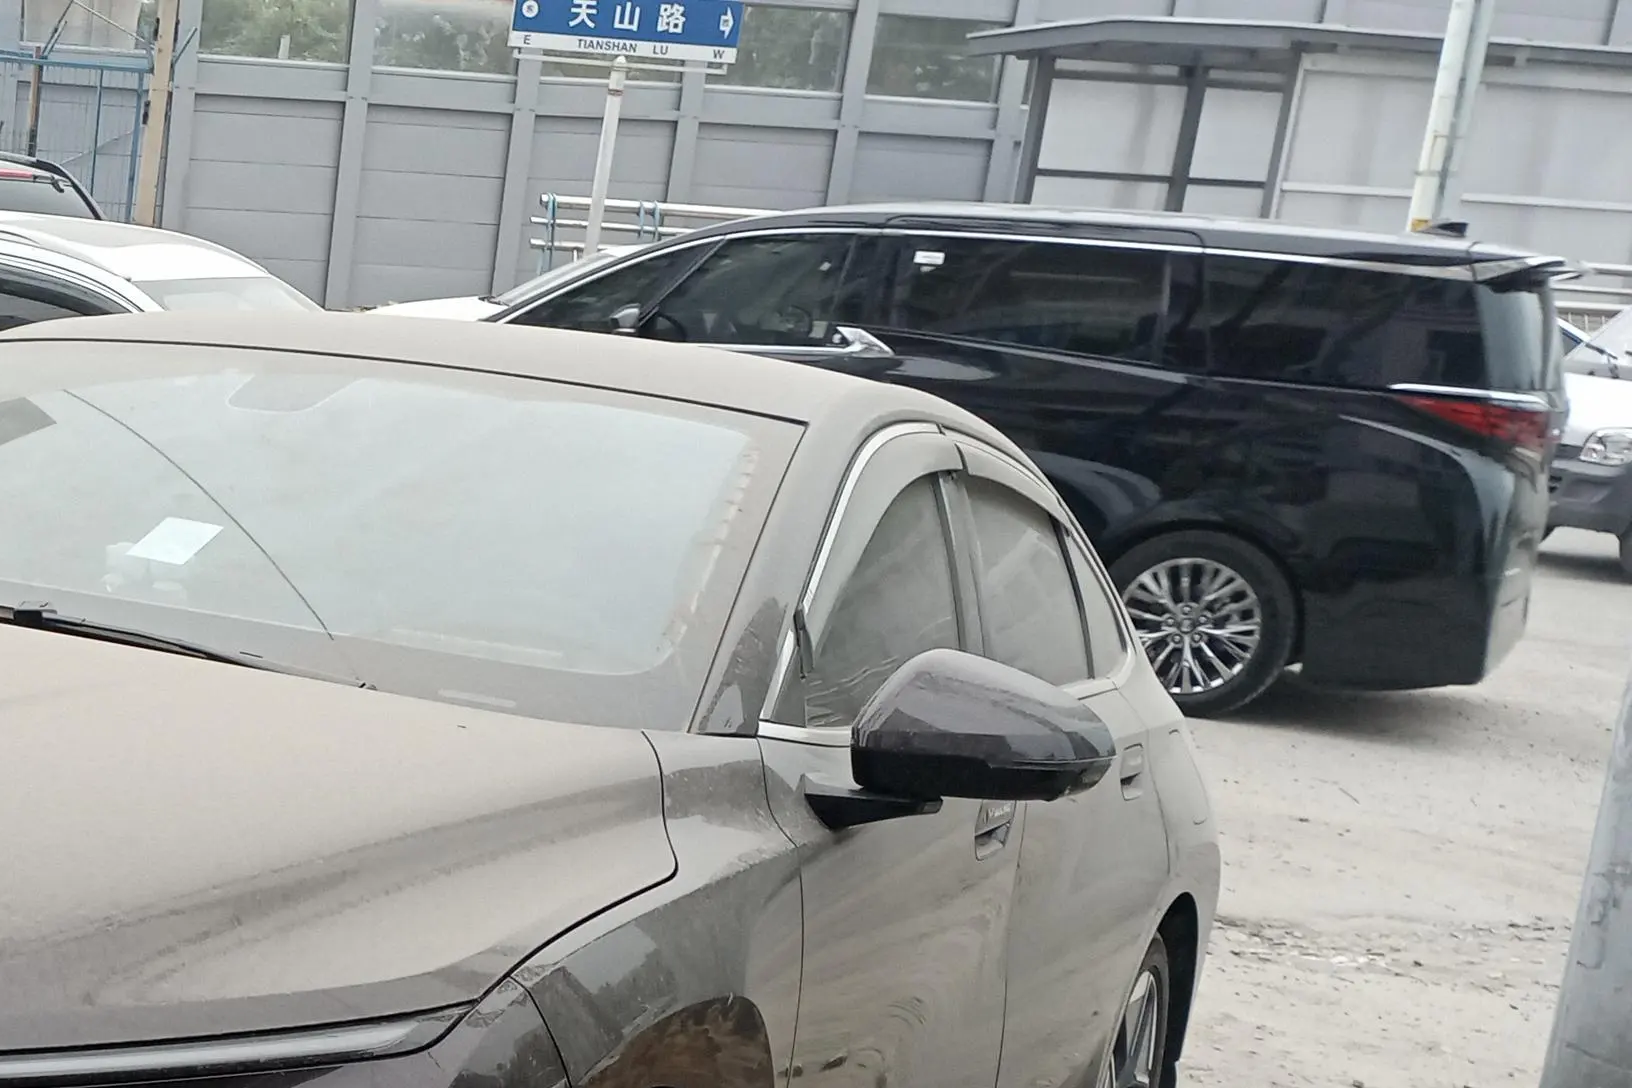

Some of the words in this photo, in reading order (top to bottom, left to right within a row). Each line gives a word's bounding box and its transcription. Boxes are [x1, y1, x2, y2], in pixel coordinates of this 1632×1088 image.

[568, 0, 686, 33] 天山路
[523, 34, 532, 45] E
[577, 38, 638, 53] TIANSHAN
[653, 44, 669, 55] LU
[713, 49, 725, 59] W
